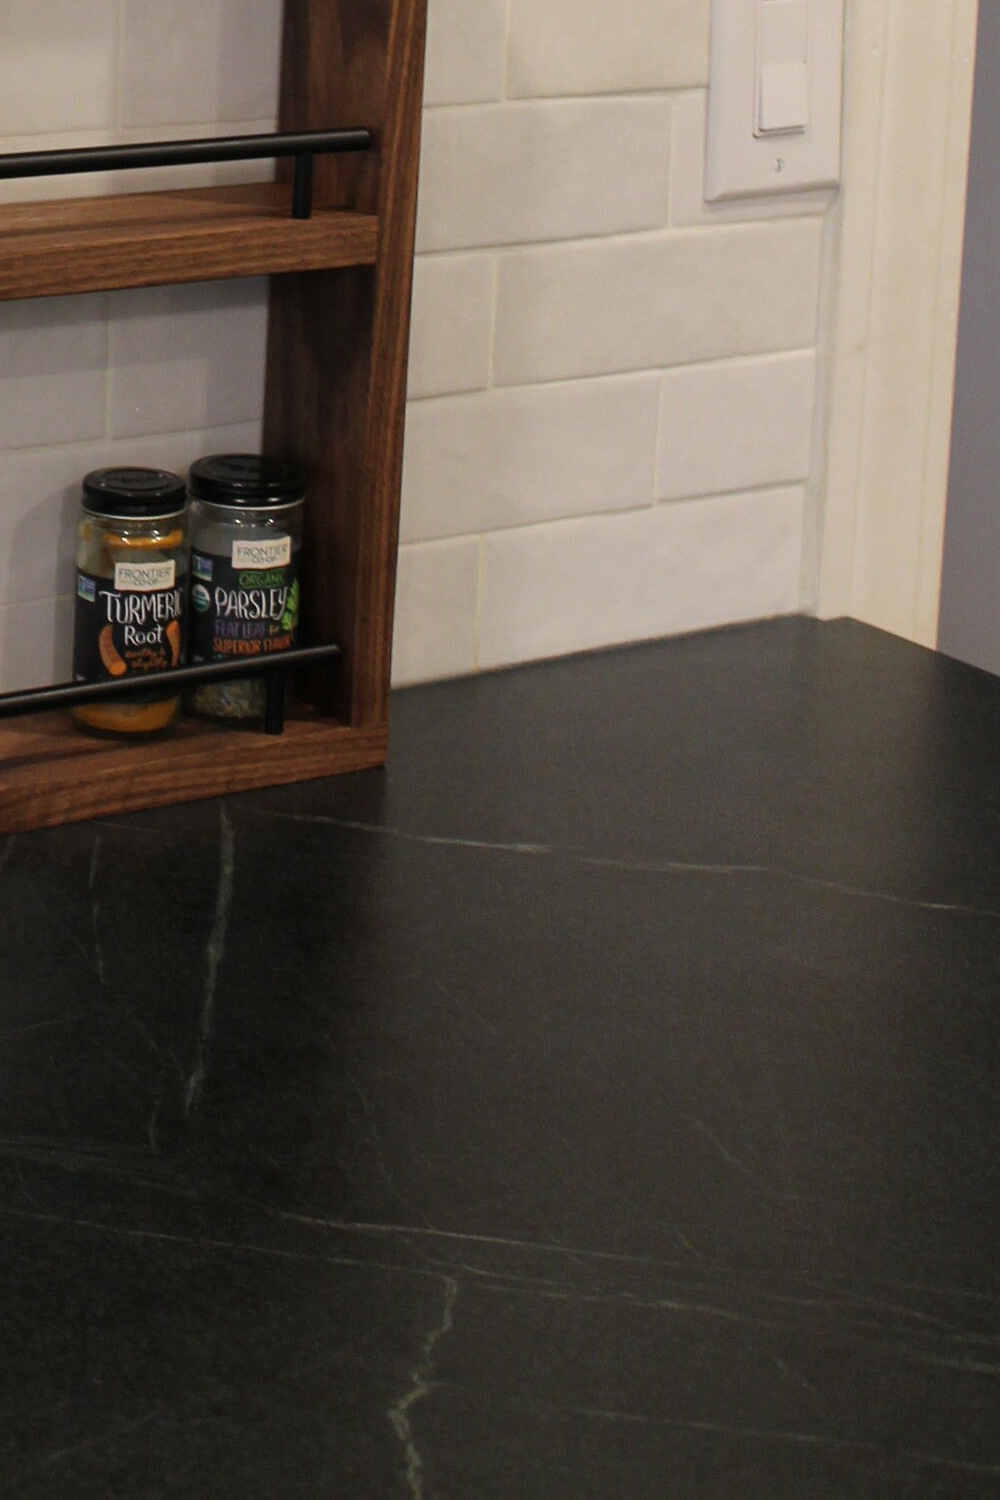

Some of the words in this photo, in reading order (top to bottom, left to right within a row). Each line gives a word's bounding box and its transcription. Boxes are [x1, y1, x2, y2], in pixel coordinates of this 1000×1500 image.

[236, 544, 289, 558] FRONTIER
[119, 566, 173, 580] FRONTIER
[214, 586, 288, 621] PARSLEY
[124, 624, 164, 646] Root
[213, 636, 261, 655] SUPERIOR
